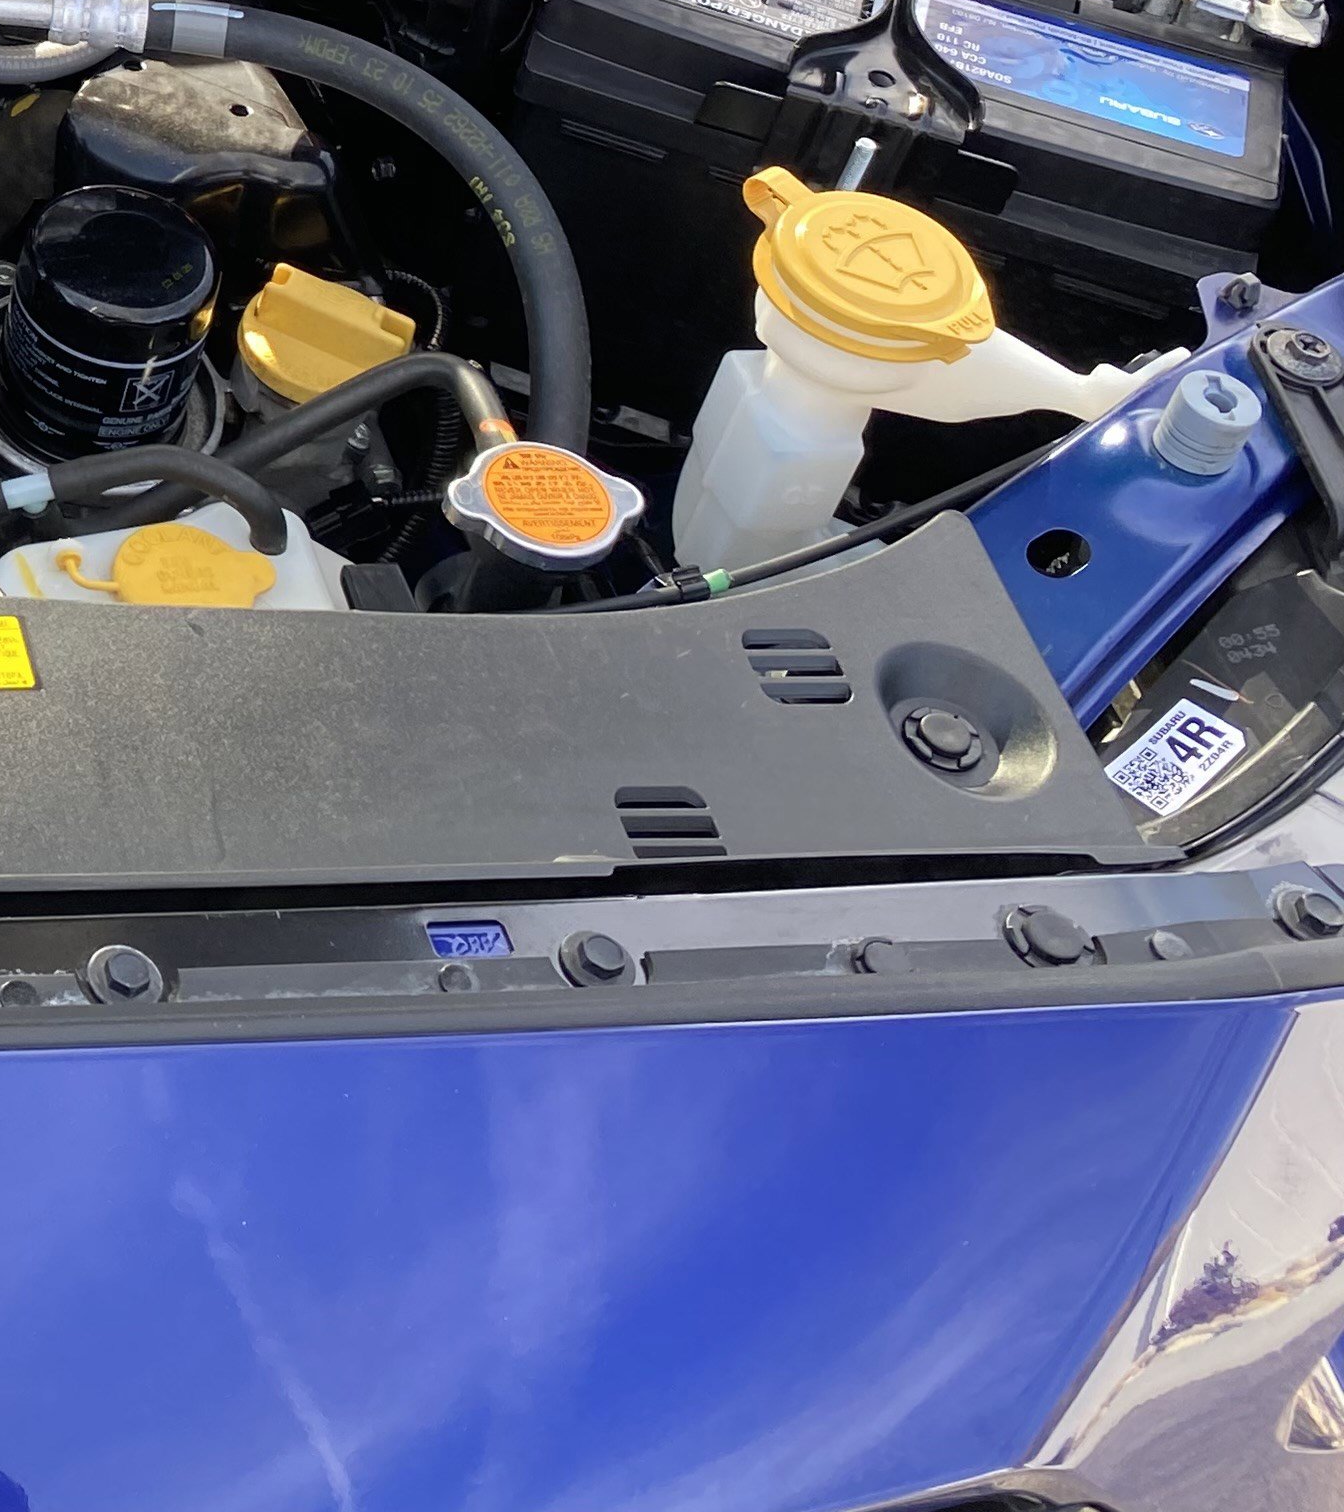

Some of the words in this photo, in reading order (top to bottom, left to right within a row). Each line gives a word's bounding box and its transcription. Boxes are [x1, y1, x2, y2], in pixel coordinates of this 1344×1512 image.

[946, 311, 990, 337] PULL
[122, 528, 226, 566] COOLANT
[1148, 710, 1187, 745] SUBARU
[1165, 716, 1226, 765] 4R
